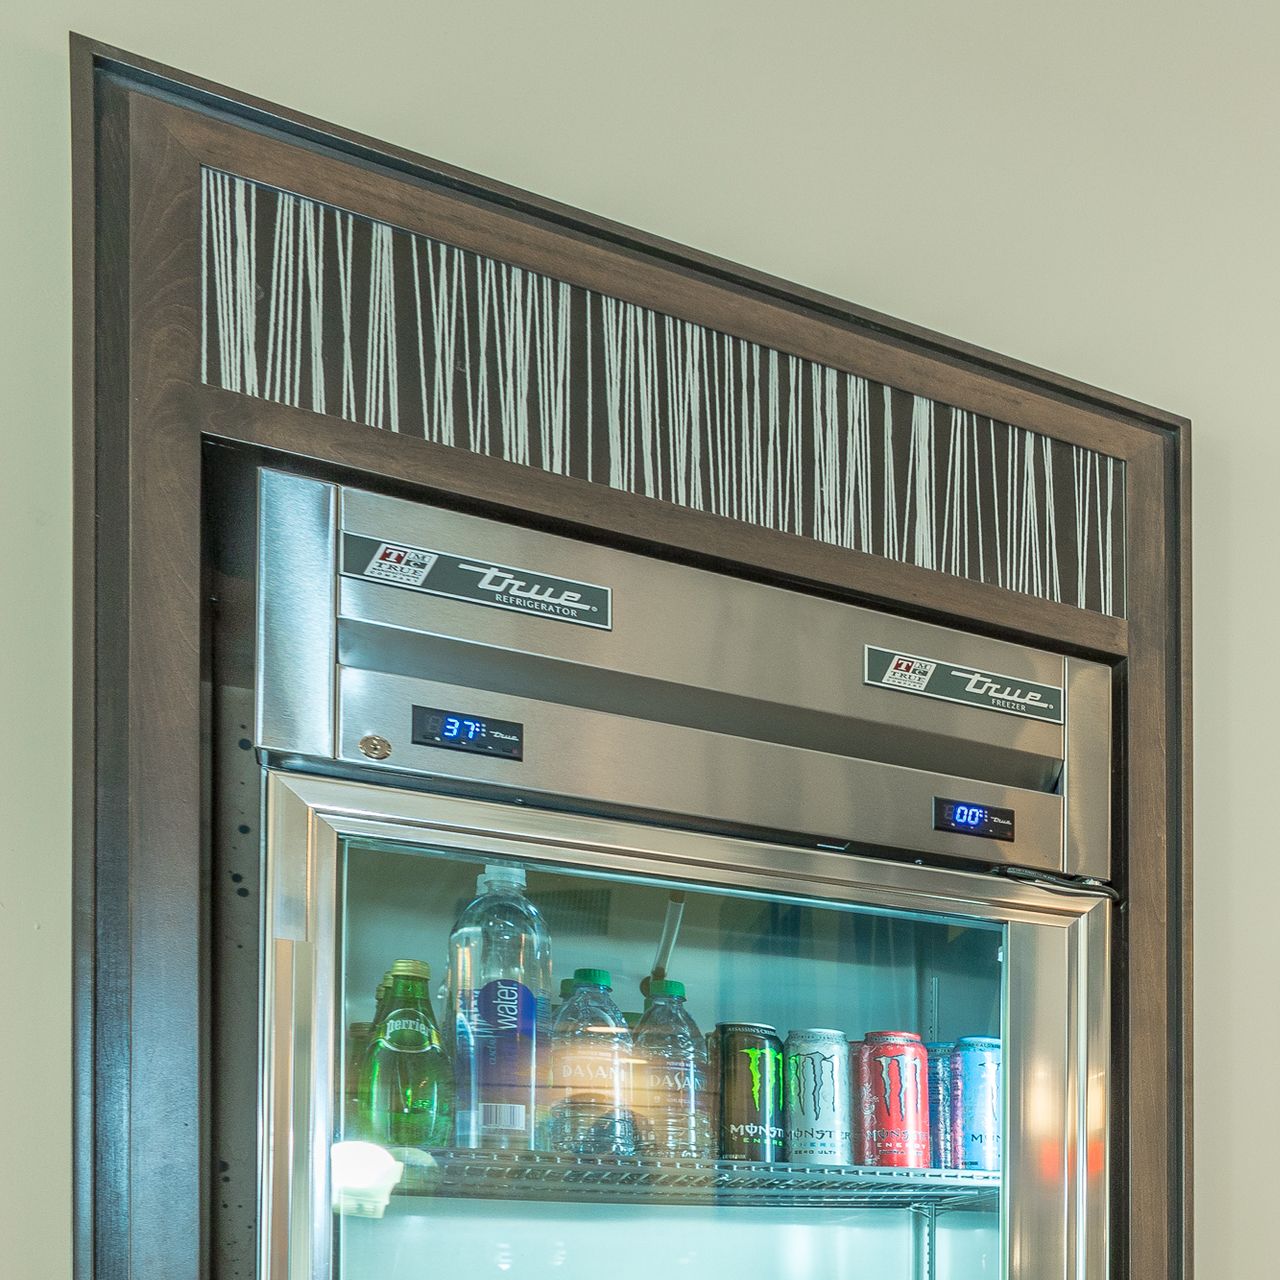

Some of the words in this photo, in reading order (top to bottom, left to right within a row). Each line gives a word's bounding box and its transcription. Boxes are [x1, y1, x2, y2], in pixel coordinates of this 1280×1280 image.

[495, 594, 578, 617] REFRIGERATOR
[991, 698, 1026, 712] FREEZER
[492, 982, 519, 1030] water
